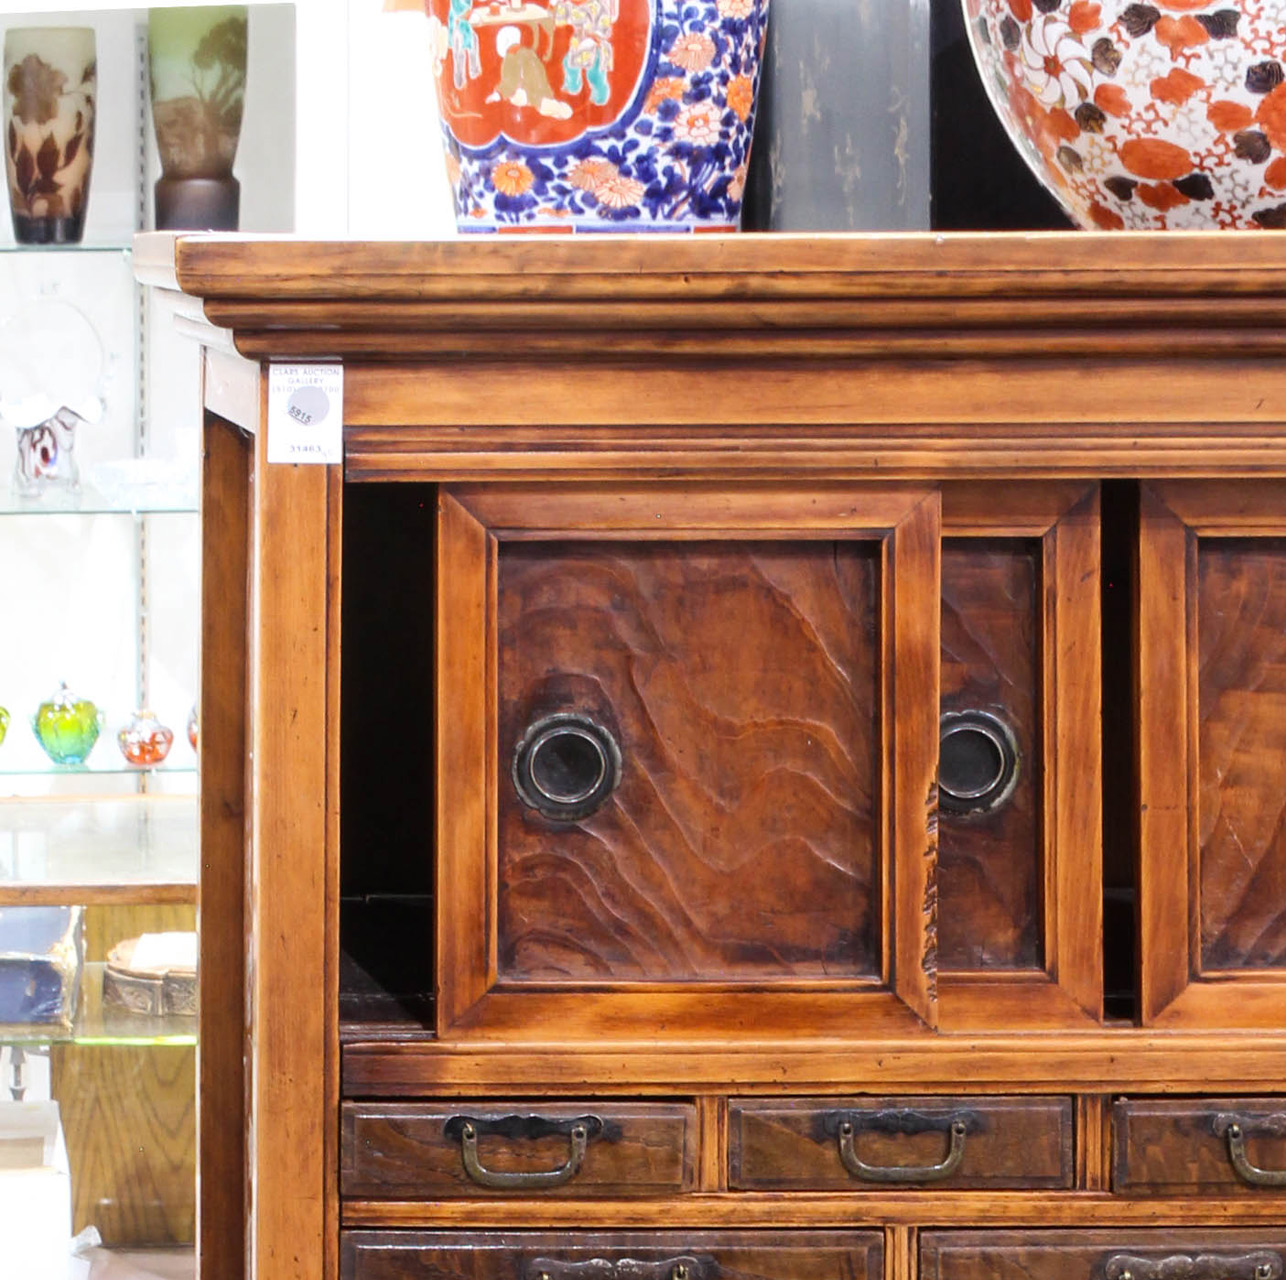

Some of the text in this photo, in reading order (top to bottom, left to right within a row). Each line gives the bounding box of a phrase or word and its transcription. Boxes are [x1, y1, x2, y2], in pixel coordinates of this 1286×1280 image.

[303, 367, 340, 376] AUCTION
[287, 377, 324, 385] GALLERY
[288, 405, 312, 424] 5915
